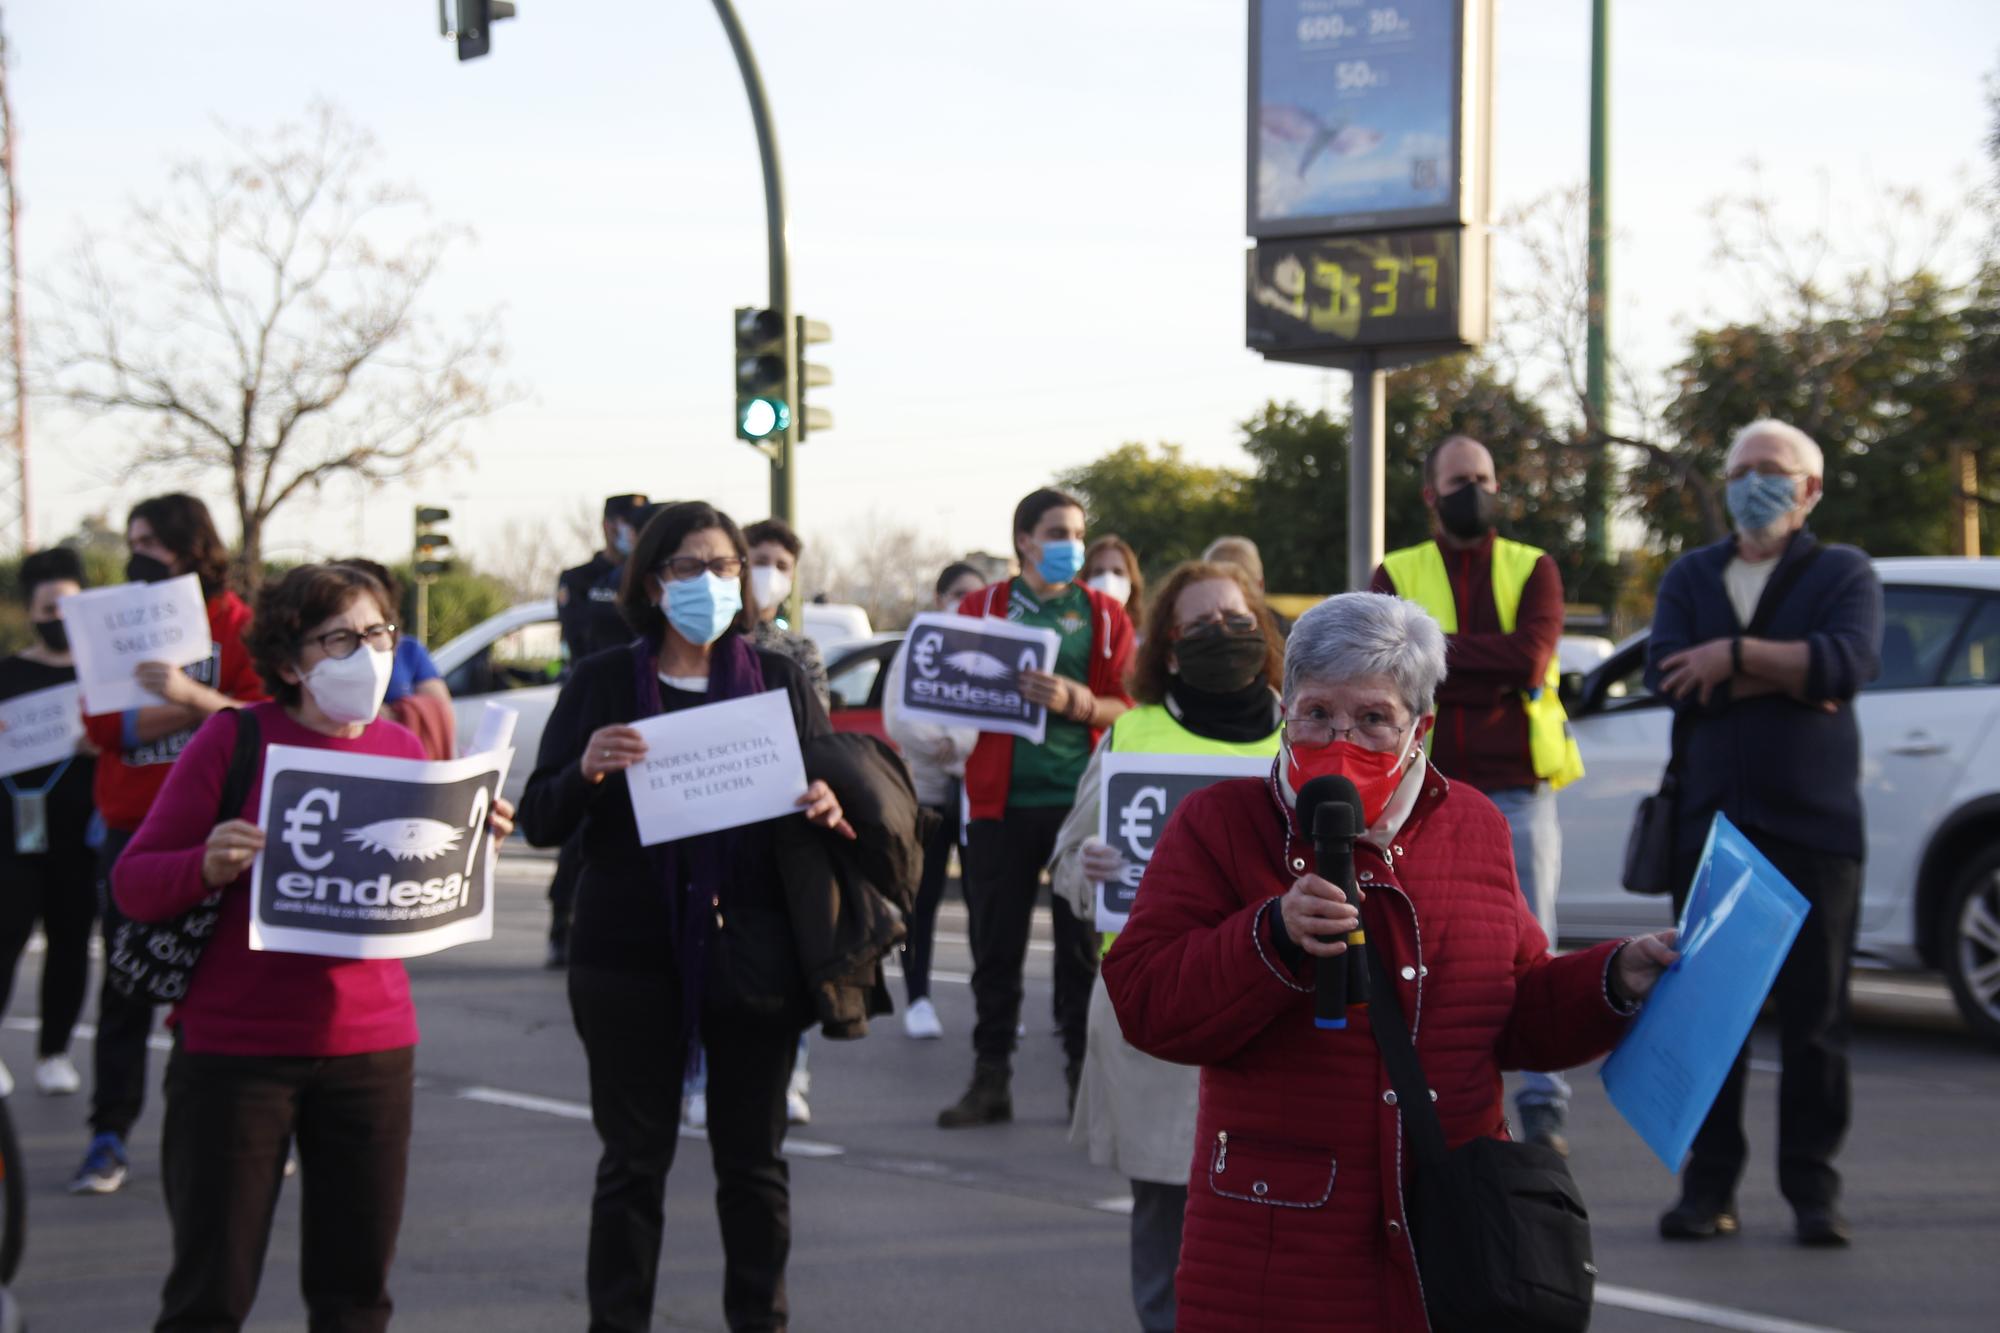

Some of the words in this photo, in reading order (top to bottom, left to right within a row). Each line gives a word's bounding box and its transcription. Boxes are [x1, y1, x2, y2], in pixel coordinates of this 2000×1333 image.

[911, 678, 1021, 708] endesa
[650, 776, 666, 791] EL
[684, 788, 703, 801] EN
[706, 774, 754, 797] LUCHA
